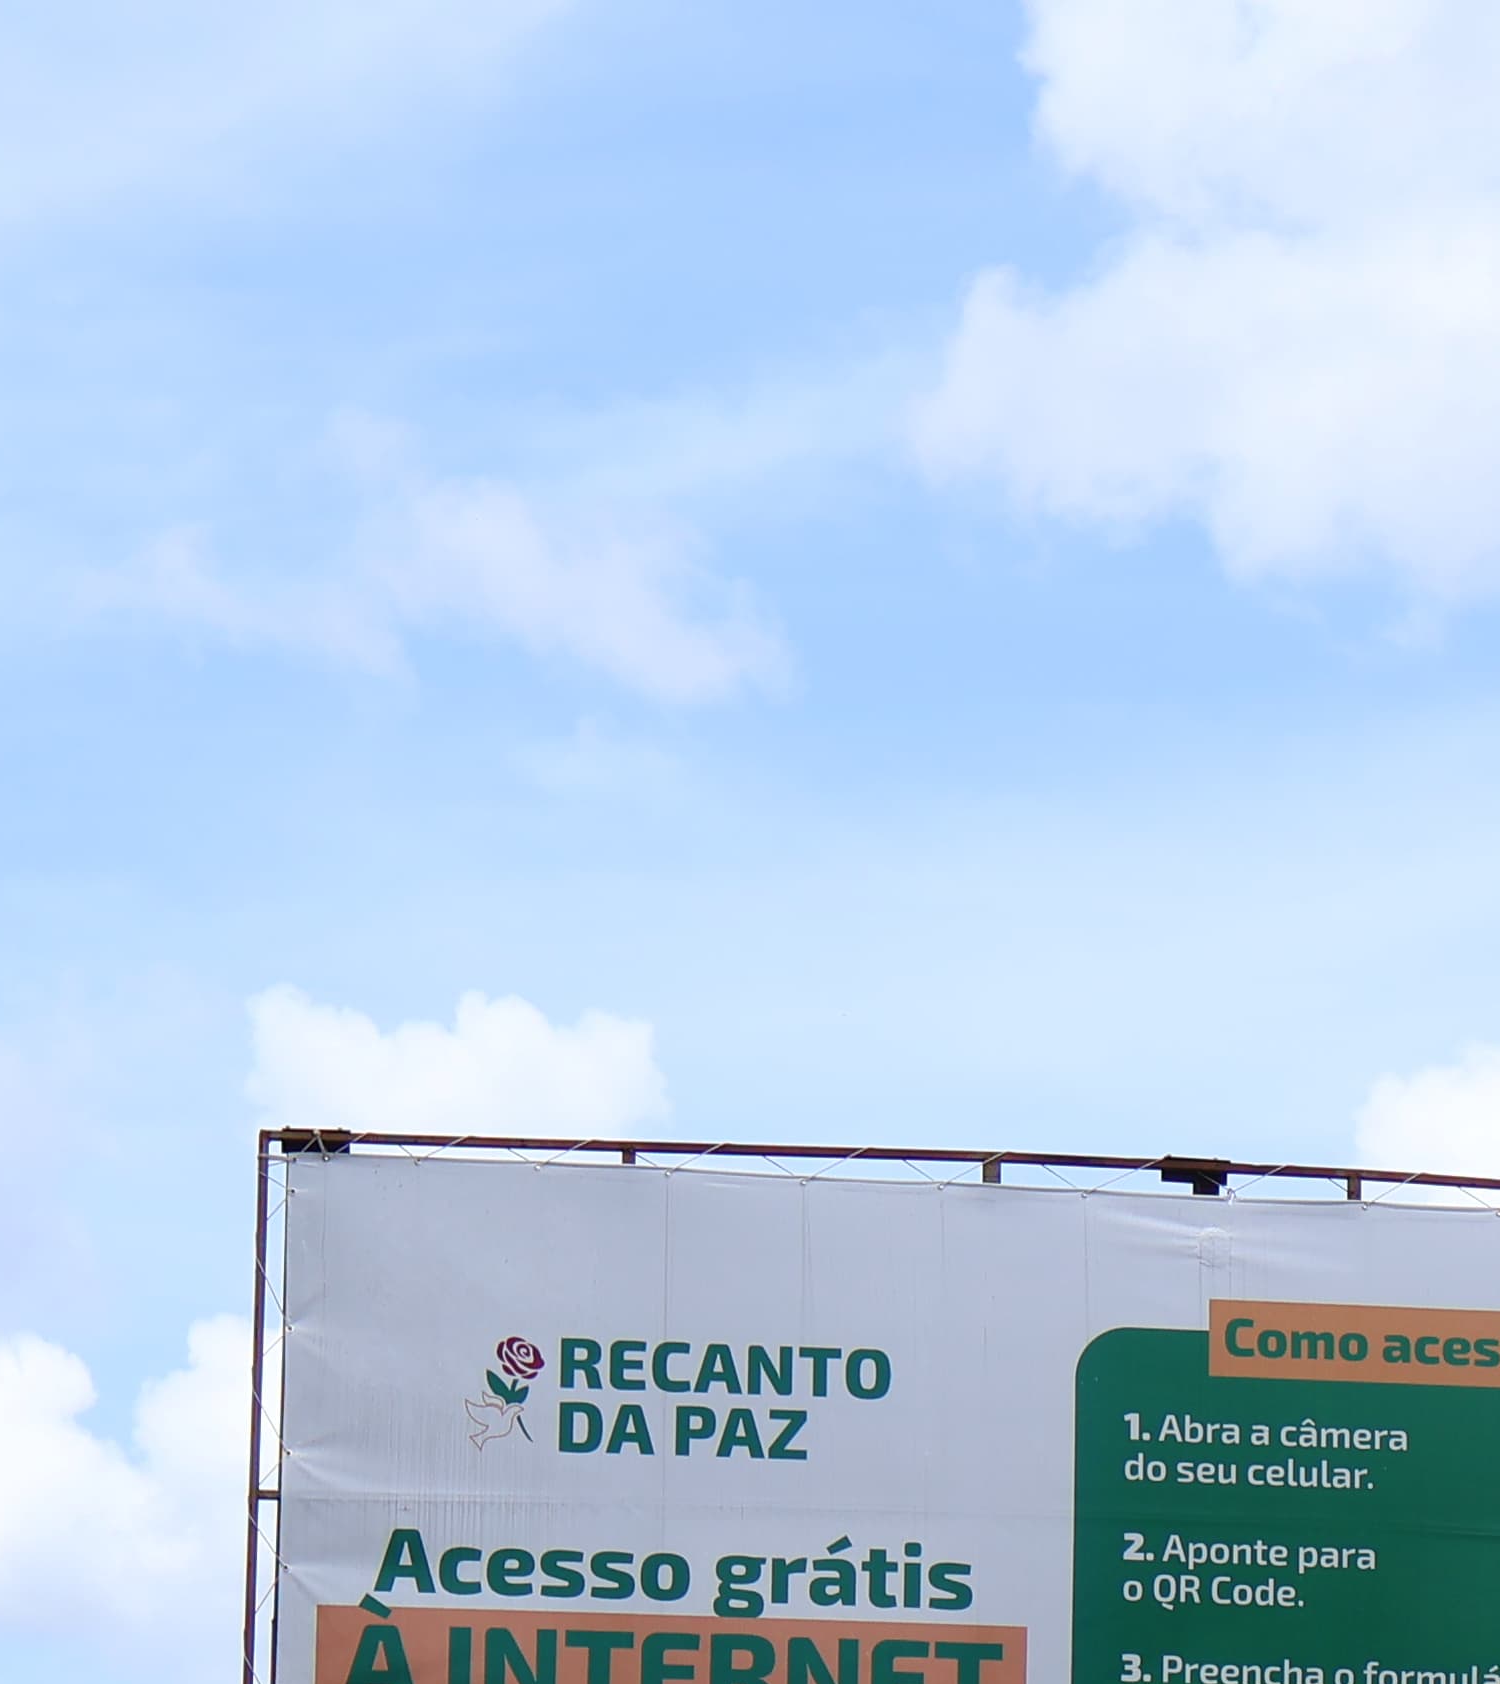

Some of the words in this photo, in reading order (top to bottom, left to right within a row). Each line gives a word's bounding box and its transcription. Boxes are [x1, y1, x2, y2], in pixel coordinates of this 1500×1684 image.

[1224, 1317, 1369, 1362] Como
[559, 1337, 892, 1400] RECANTO
[558, 1401, 655, 1455] DA
[675, 1405, 808, 1461] PAZ
[1123, 1412, 1151, 1441] 1.
[1158, 1414, 1240, 1444] Abra
[1250, 1424, 1270, 1446] a
[1280, 1418, 1408, 1451] câmera
[1124, 1452, 1167, 1482] do
[1176, 1462, 1237, 1484] seu
[1247, 1458, 1374, 1490] celular.
[372, 1527, 692, 1601] Acesso
[712, 1535, 973, 1619] grátis
[1122, 1532, 1155, 1561] 2.
[1162, 1534, 1288, 1570] Aponte
[1298, 1546, 1376, 1574] para
[1123, 1580, 1143, 1602] o
[1153, 1574, 1201, 1611] QR
[1211, 1576, 1304, 1607] Code.
[1120, 1653, 1152, 1683] 3.
